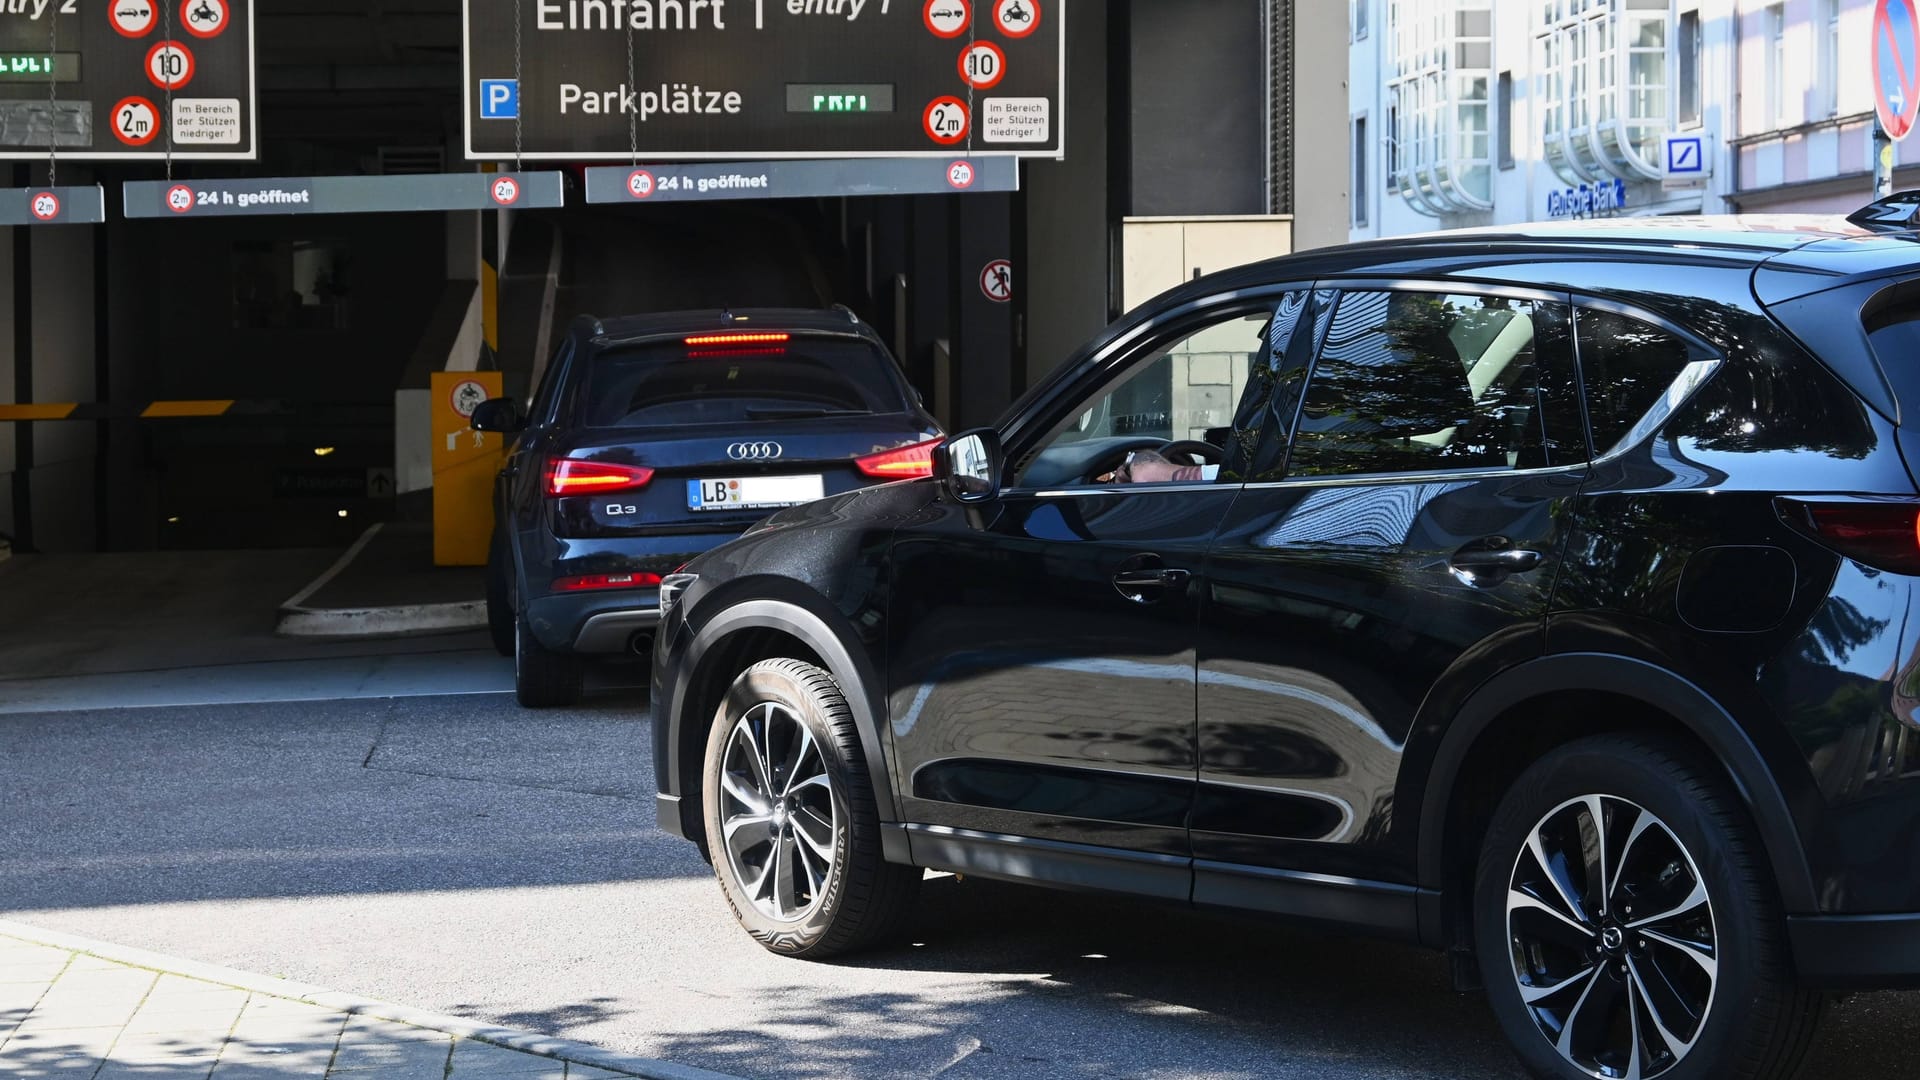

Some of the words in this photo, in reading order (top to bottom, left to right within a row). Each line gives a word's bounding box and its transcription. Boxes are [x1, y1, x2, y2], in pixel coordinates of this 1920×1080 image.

[537, 0, 725, 30] Einfahrt
[786, 0, 866, 21] entry
[158, 54, 182, 76] 10
[970, 53, 994, 76] 10
[179, 105, 191, 113] Im
[195, 104, 233, 113] Bereich
[489, 84, 510, 114] P
[560, 83, 742, 121] Parkplätze
[989, 103, 1002, 112] Im
[1005, 103, 1042, 112] Bereich
[176, 117, 194, 126] der
[198, 116, 236, 126] Stützen
[987, 115, 1004, 125] der
[1008, 115, 1045, 125] Stützen
[179, 129, 225, 140] niedriger
[990, 127, 1034, 138] niedriger
[657, 176, 679, 190] 24
[683, 176, 694, 190] h
[697, 174, 768, 193] geöffnet
[196, 191, 219, 204] 24
[222, 191, 234, 204] h
[237, 189, 309, 207] geöffnet
[1593, 178, 1626, 211] Bank
[702, 481, 727, 503] LB
[606, 504, 637, 515] Q3
[822, 826, 845, 916] VREDESTEIN
